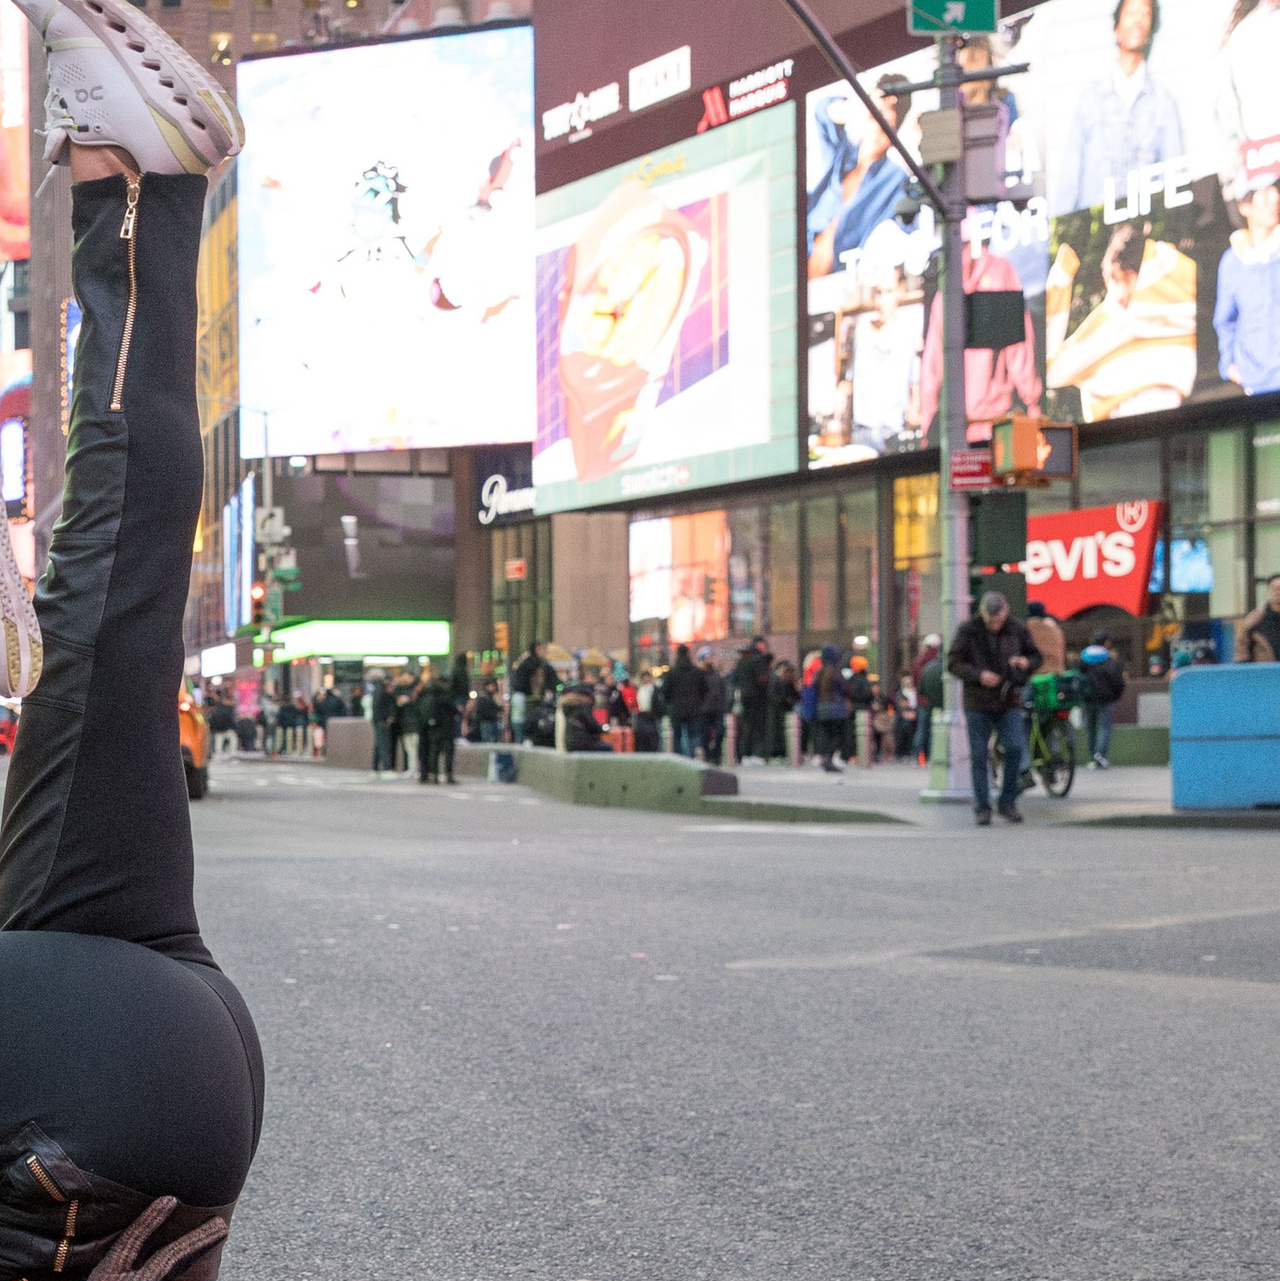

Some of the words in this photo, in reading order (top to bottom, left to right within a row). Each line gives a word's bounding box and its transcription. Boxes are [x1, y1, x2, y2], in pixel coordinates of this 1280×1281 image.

[729, 58, 794, 98] MARRIOTT
[729, 80, 788, 116] MARQUIS
[968, 197, 1049, 259] FOR
[1104, 156, 1194, 225] LIFE
[1024, 530, 1136, 586] evi's
